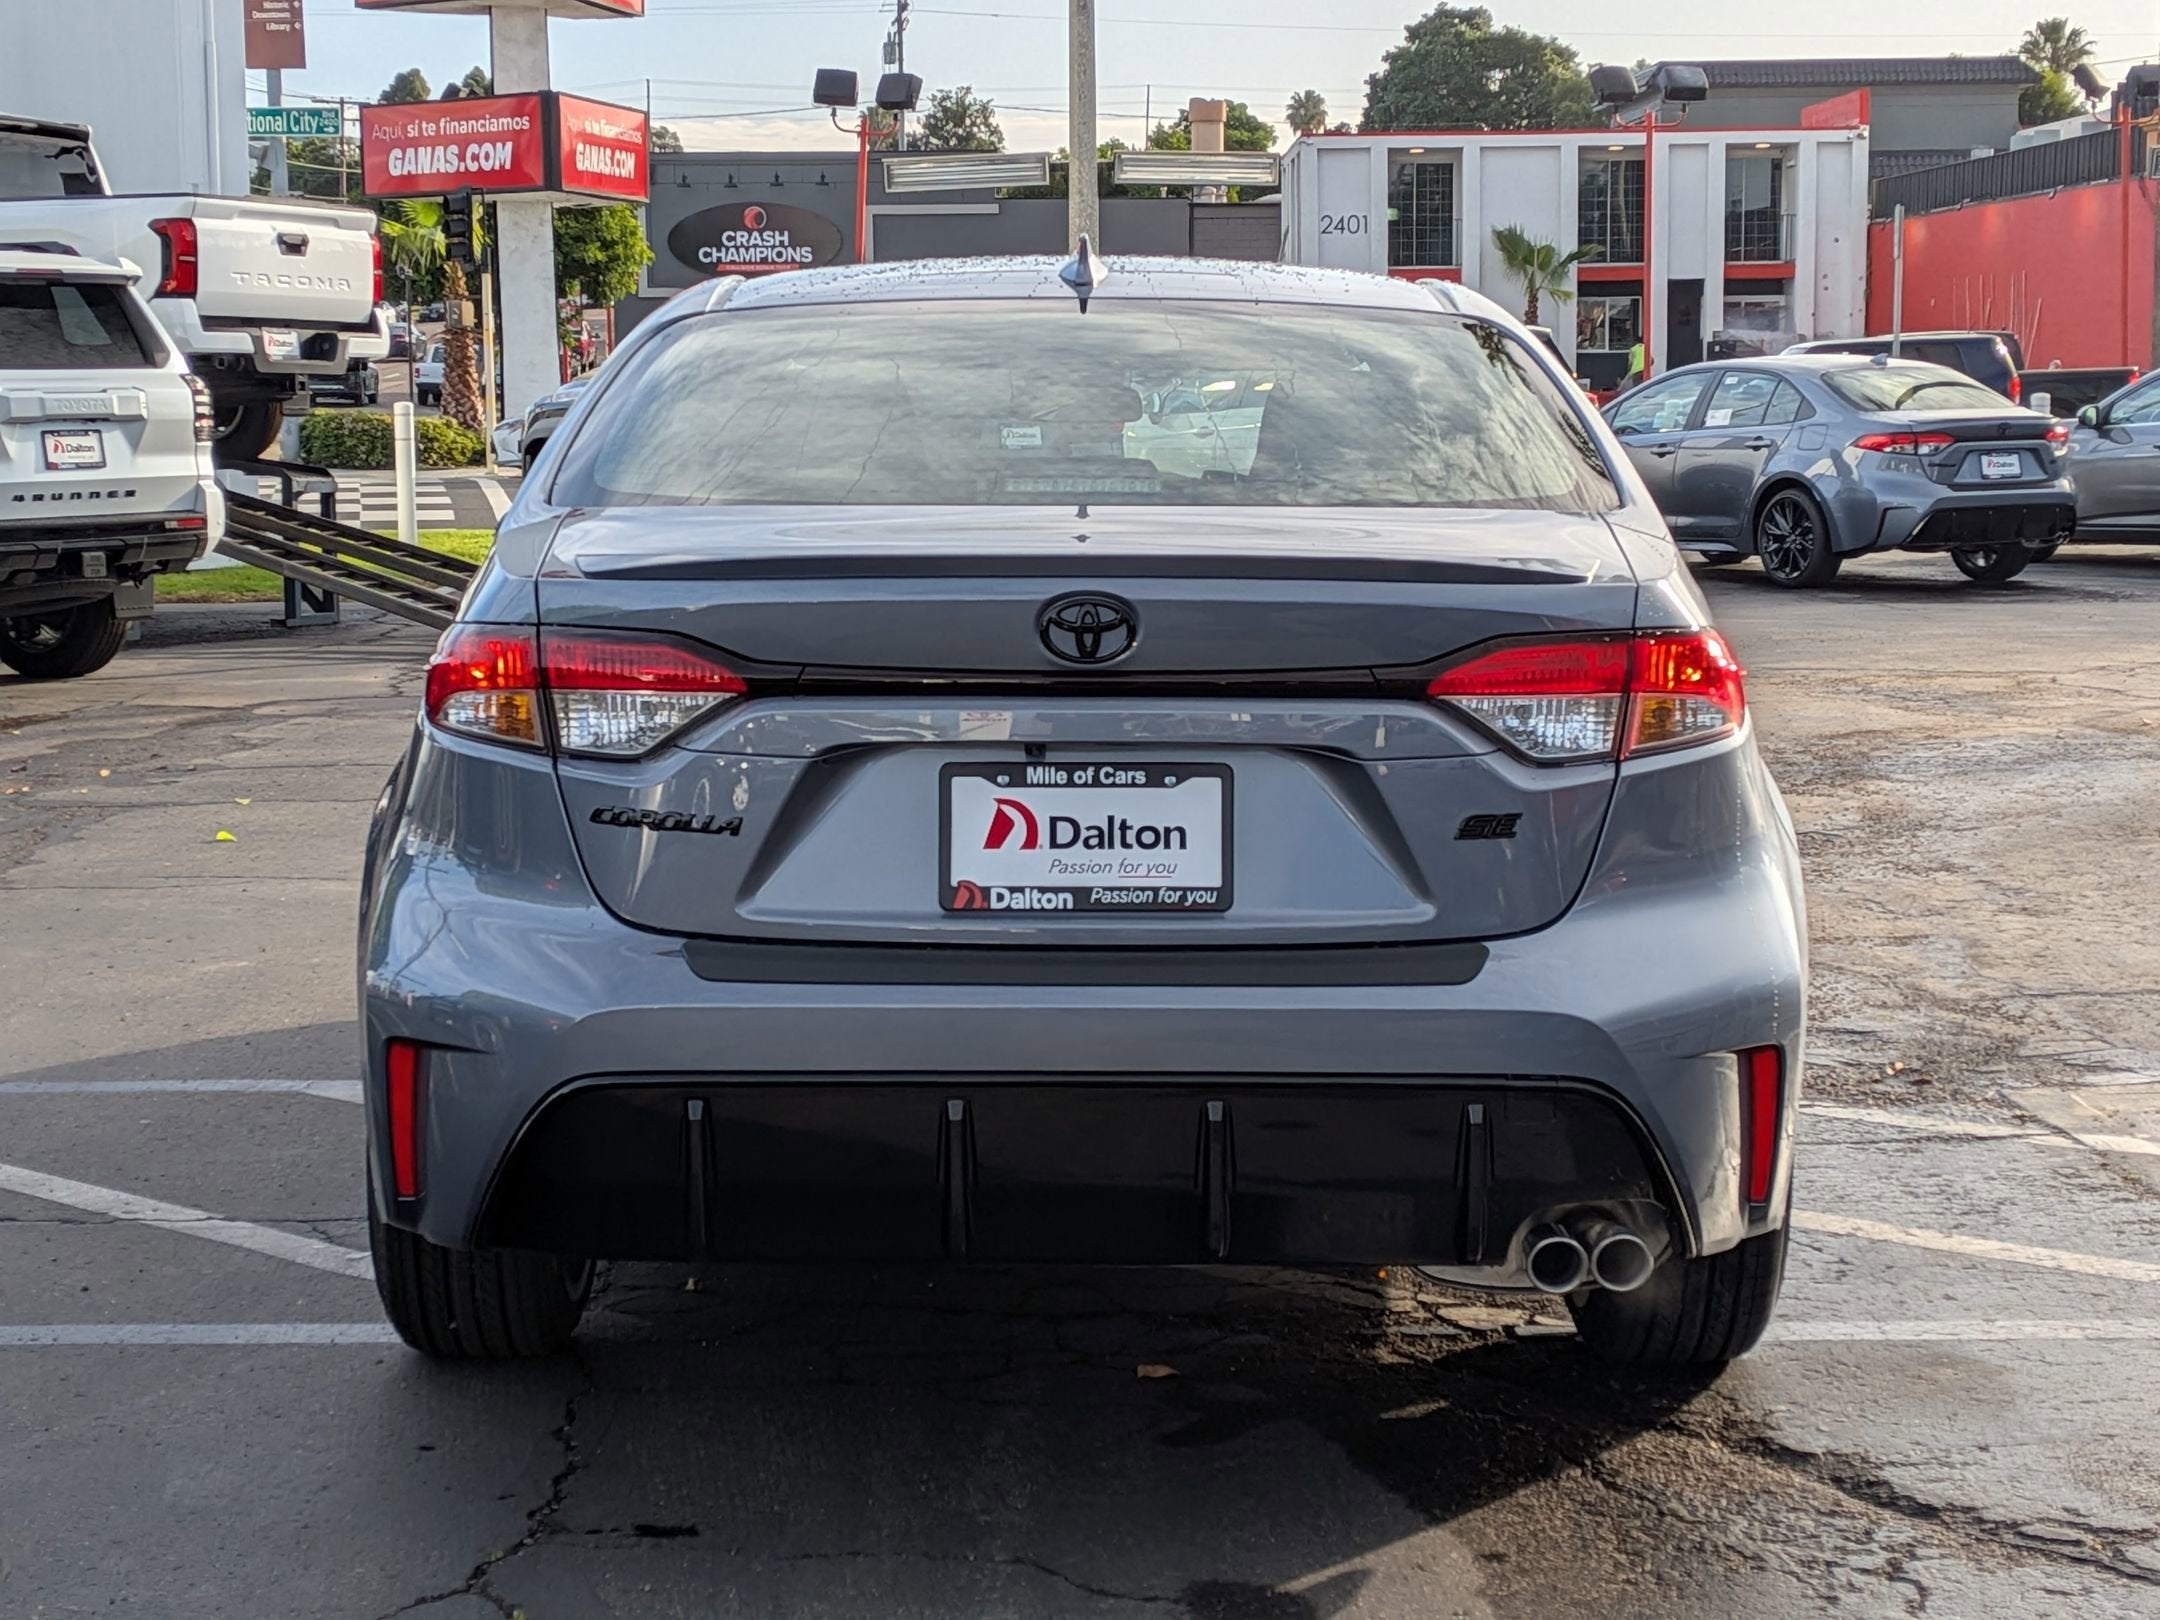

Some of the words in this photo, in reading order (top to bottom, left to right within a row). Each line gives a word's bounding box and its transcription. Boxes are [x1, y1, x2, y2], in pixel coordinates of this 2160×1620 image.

[265, 22, 291, 32] Library
[290, 111, 319, 134] City
[407, 119, 419, 138] sí
[422, 121, 437, 137] te
[439, 114, 531, 136] financiamos
[388, 141, 513, 177] GANAS.COM
[575, 141, 636, 180] GANAS.COM
[1320, 214, 1368, 235] 2401
[721, 230, 789, 247] CRASH
[698, 246, 813, 263] CHAMPIONS
[230, 271, 351, 291] TACOMA
[54, 399, 108, 412] TOYOTA
[65, 443, 95, 453] Dalton
[12, 489, 137, 503] 4RUNNER
[1026, 766, 1068, 785] Mile
[1073, 766, 1095, 785] of
[1099, 766, 1147, 785] Cars
[589, 806, 744, 837] COROLLA
[1454, 812, 1524, 841] SE
[1049, 815, 1187, 850] Dalton
[1048, 858, 1113, 875] Passion
[1118, 858, 1141, 875] for
[1145, 862, 1178, 877] you
[989, 887, 1074, 910] Dalton
[1090, 887, 1154, 904] Passion
[1157, 886, 1182, 905] for
[1184, 890, 1218, 907] you
